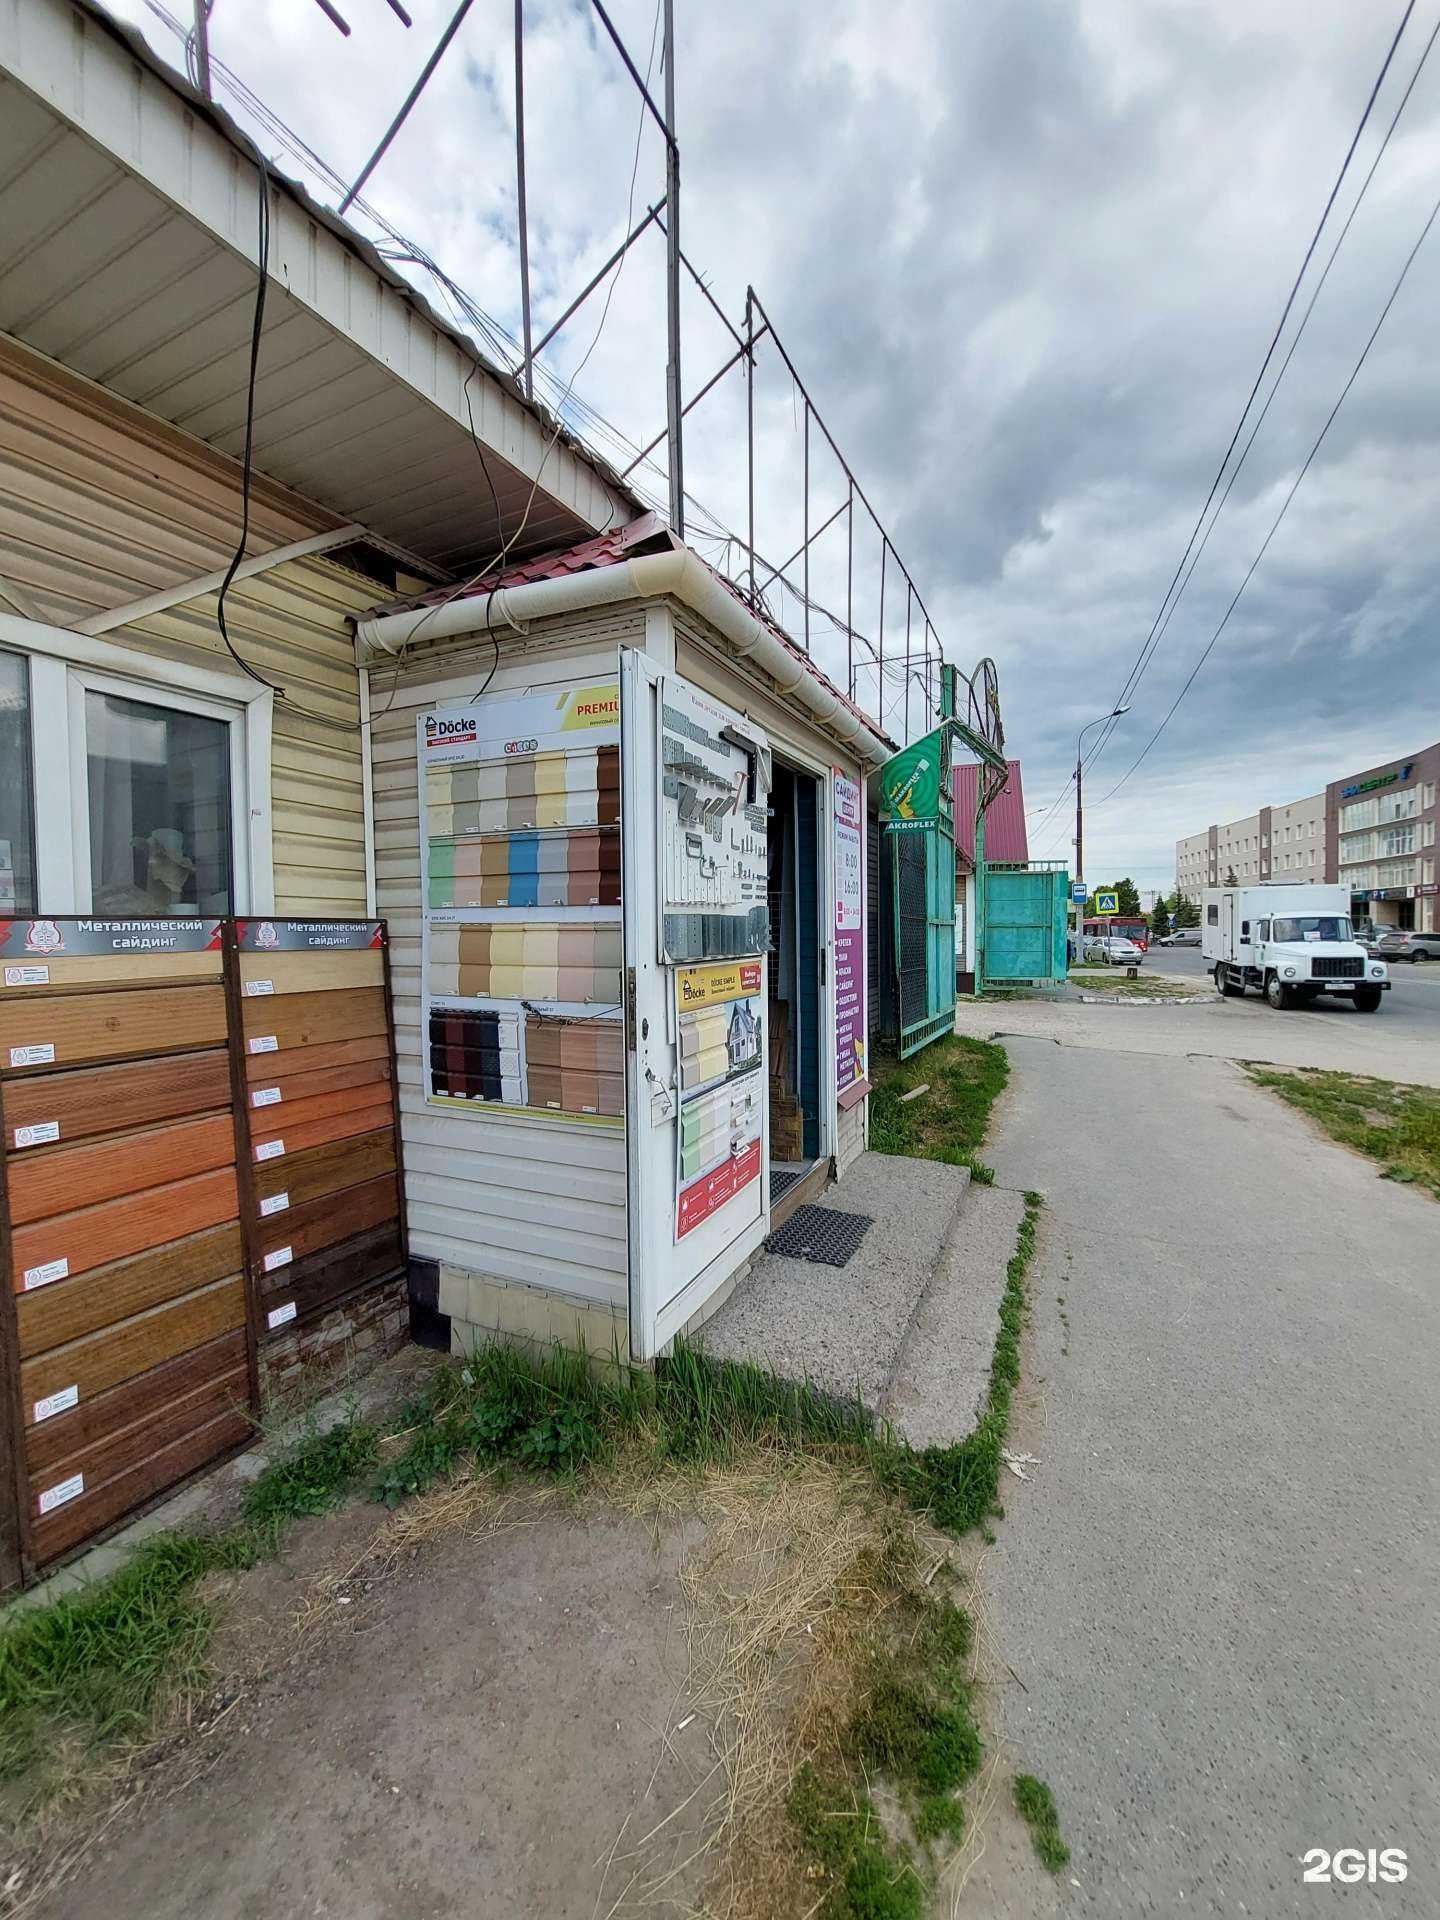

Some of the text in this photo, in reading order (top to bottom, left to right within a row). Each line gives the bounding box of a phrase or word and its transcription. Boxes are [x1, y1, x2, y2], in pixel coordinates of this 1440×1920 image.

[439, 718, 476, 735] Döcke
[77, 919, 203, 932] Металлический
[287, 922, 368, 932] Металлический
[112, 935, 177, 948] сайдинг
[308, 936, 350, 946] сайдинг
